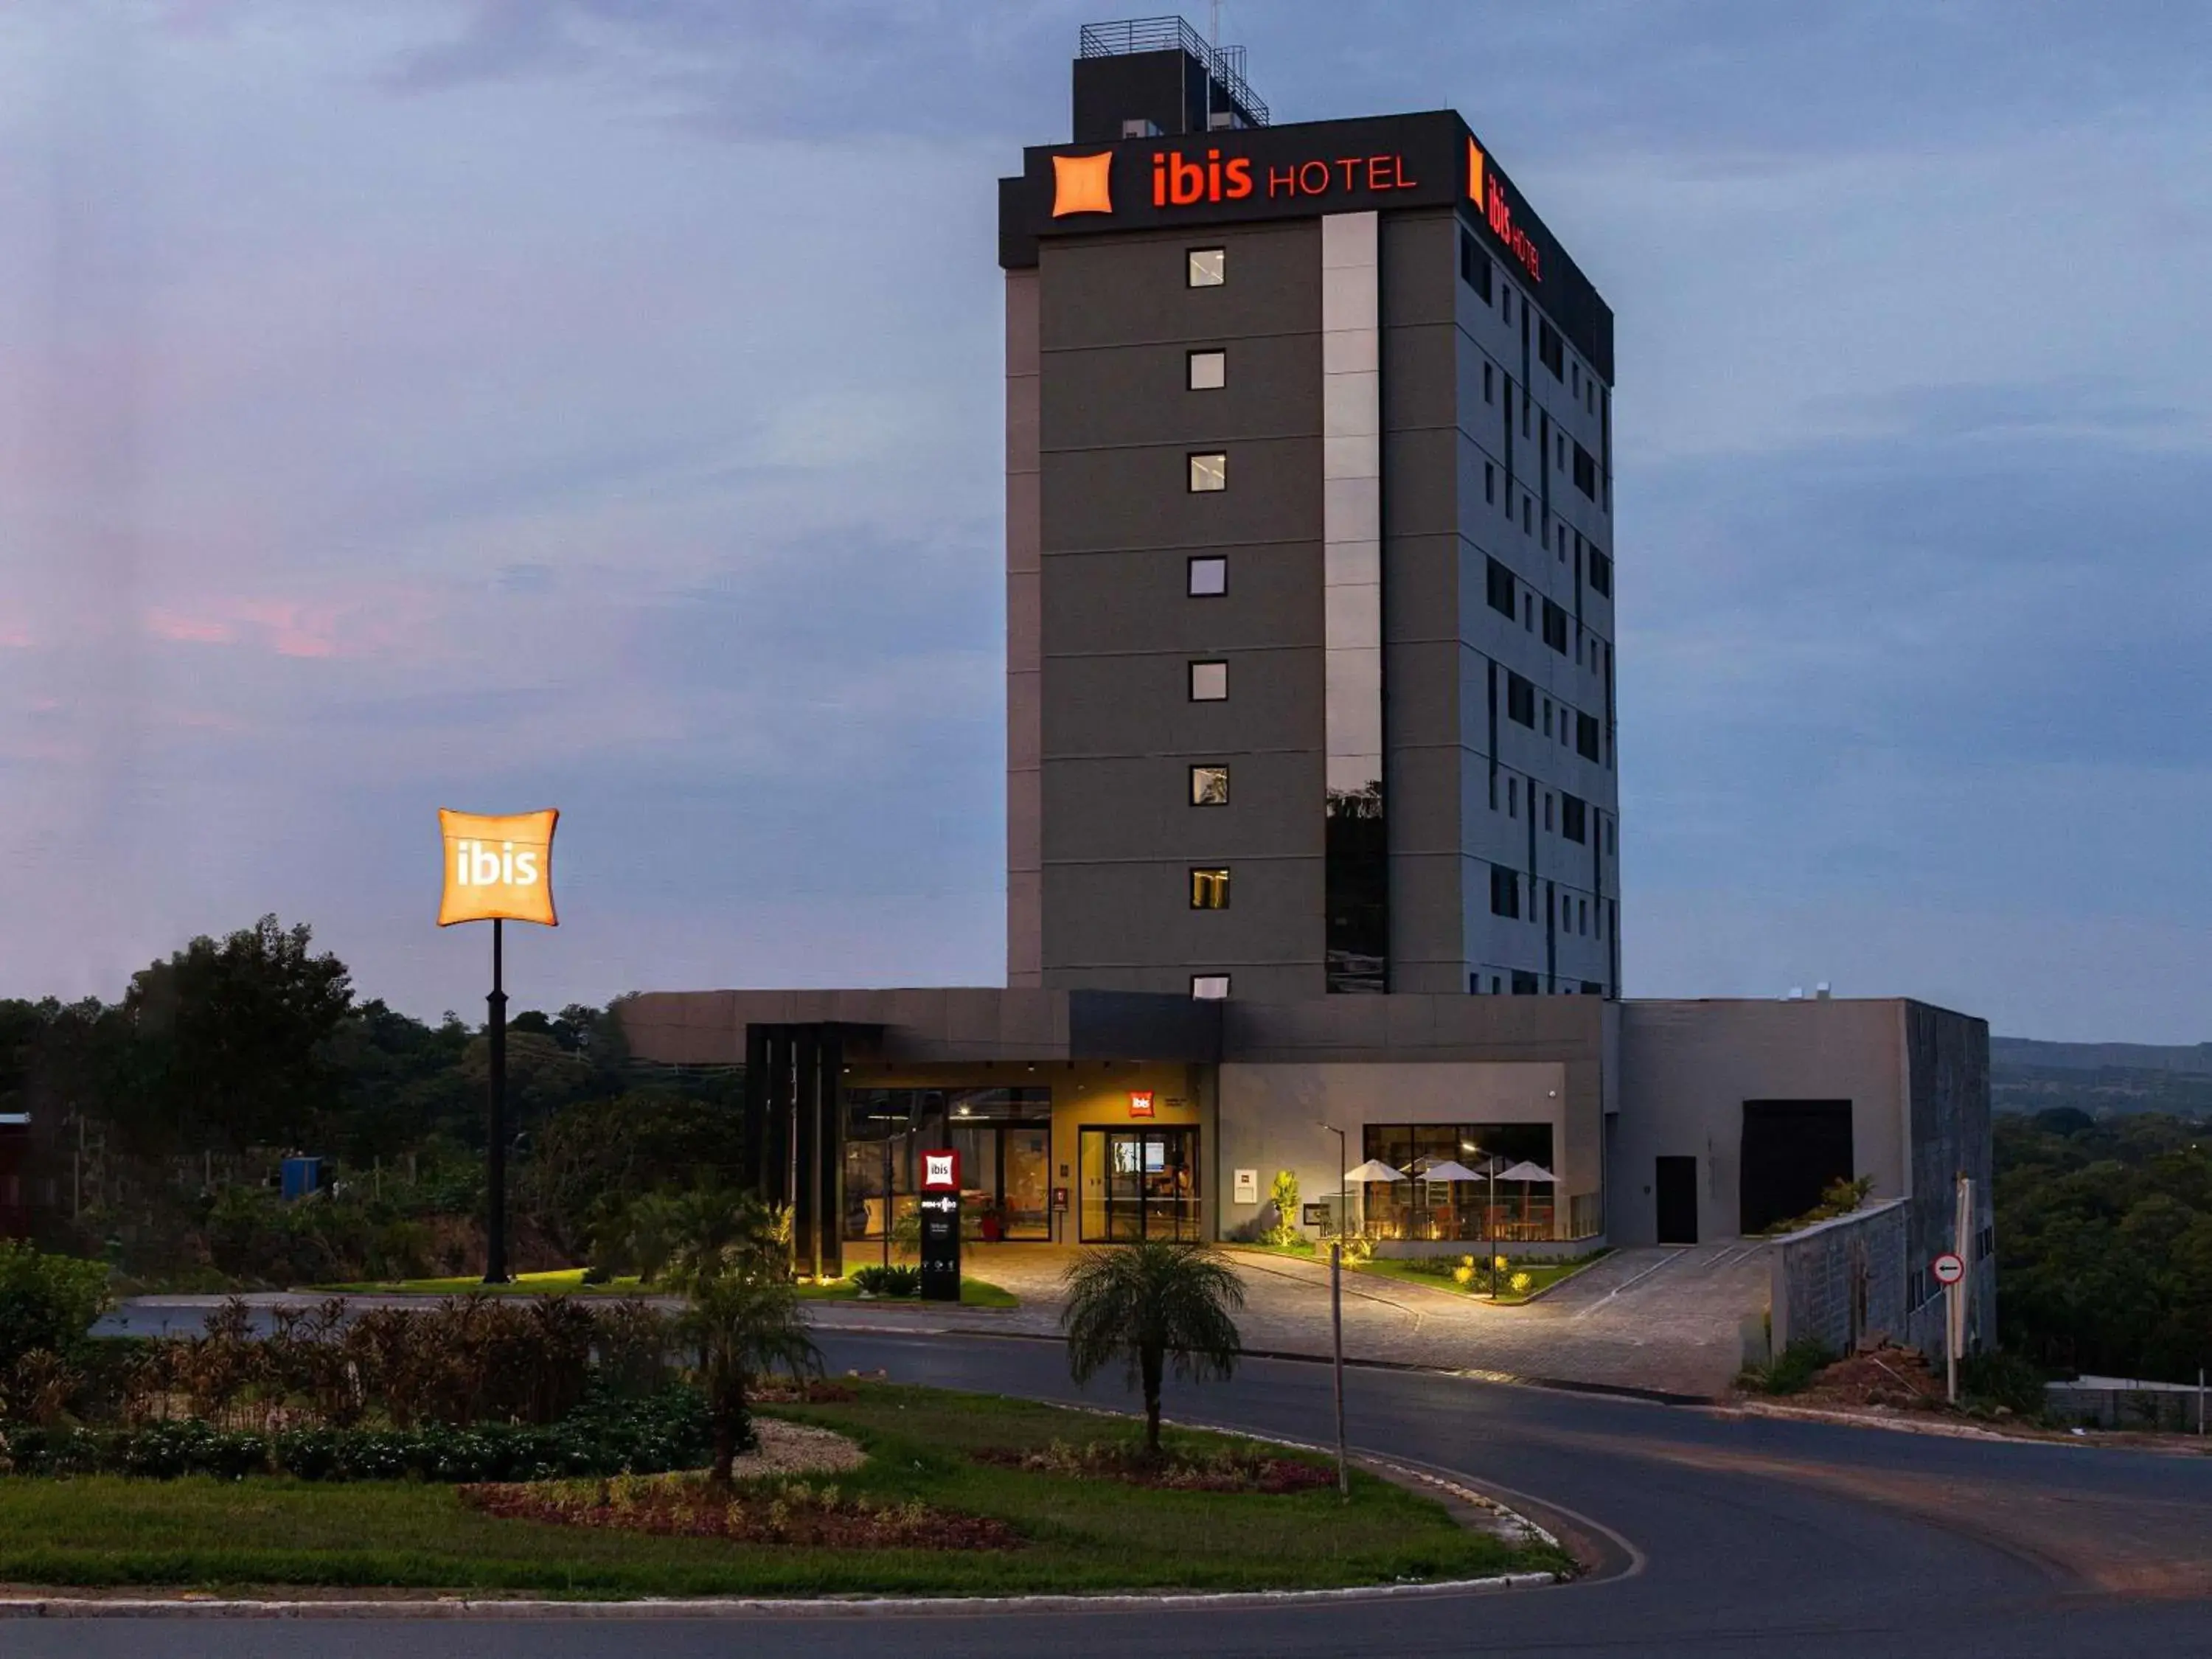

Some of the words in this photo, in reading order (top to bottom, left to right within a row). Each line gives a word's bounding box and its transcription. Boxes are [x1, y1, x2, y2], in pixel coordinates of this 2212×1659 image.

[1153, 150, 1252, 206] ibis
[1269, 156, 1418, 198] HOTEL
[1488, 173, 1511, 246] ibis
[457, 841, 538, 886] ibis
[931, 1162, 948, 1175] ibis
